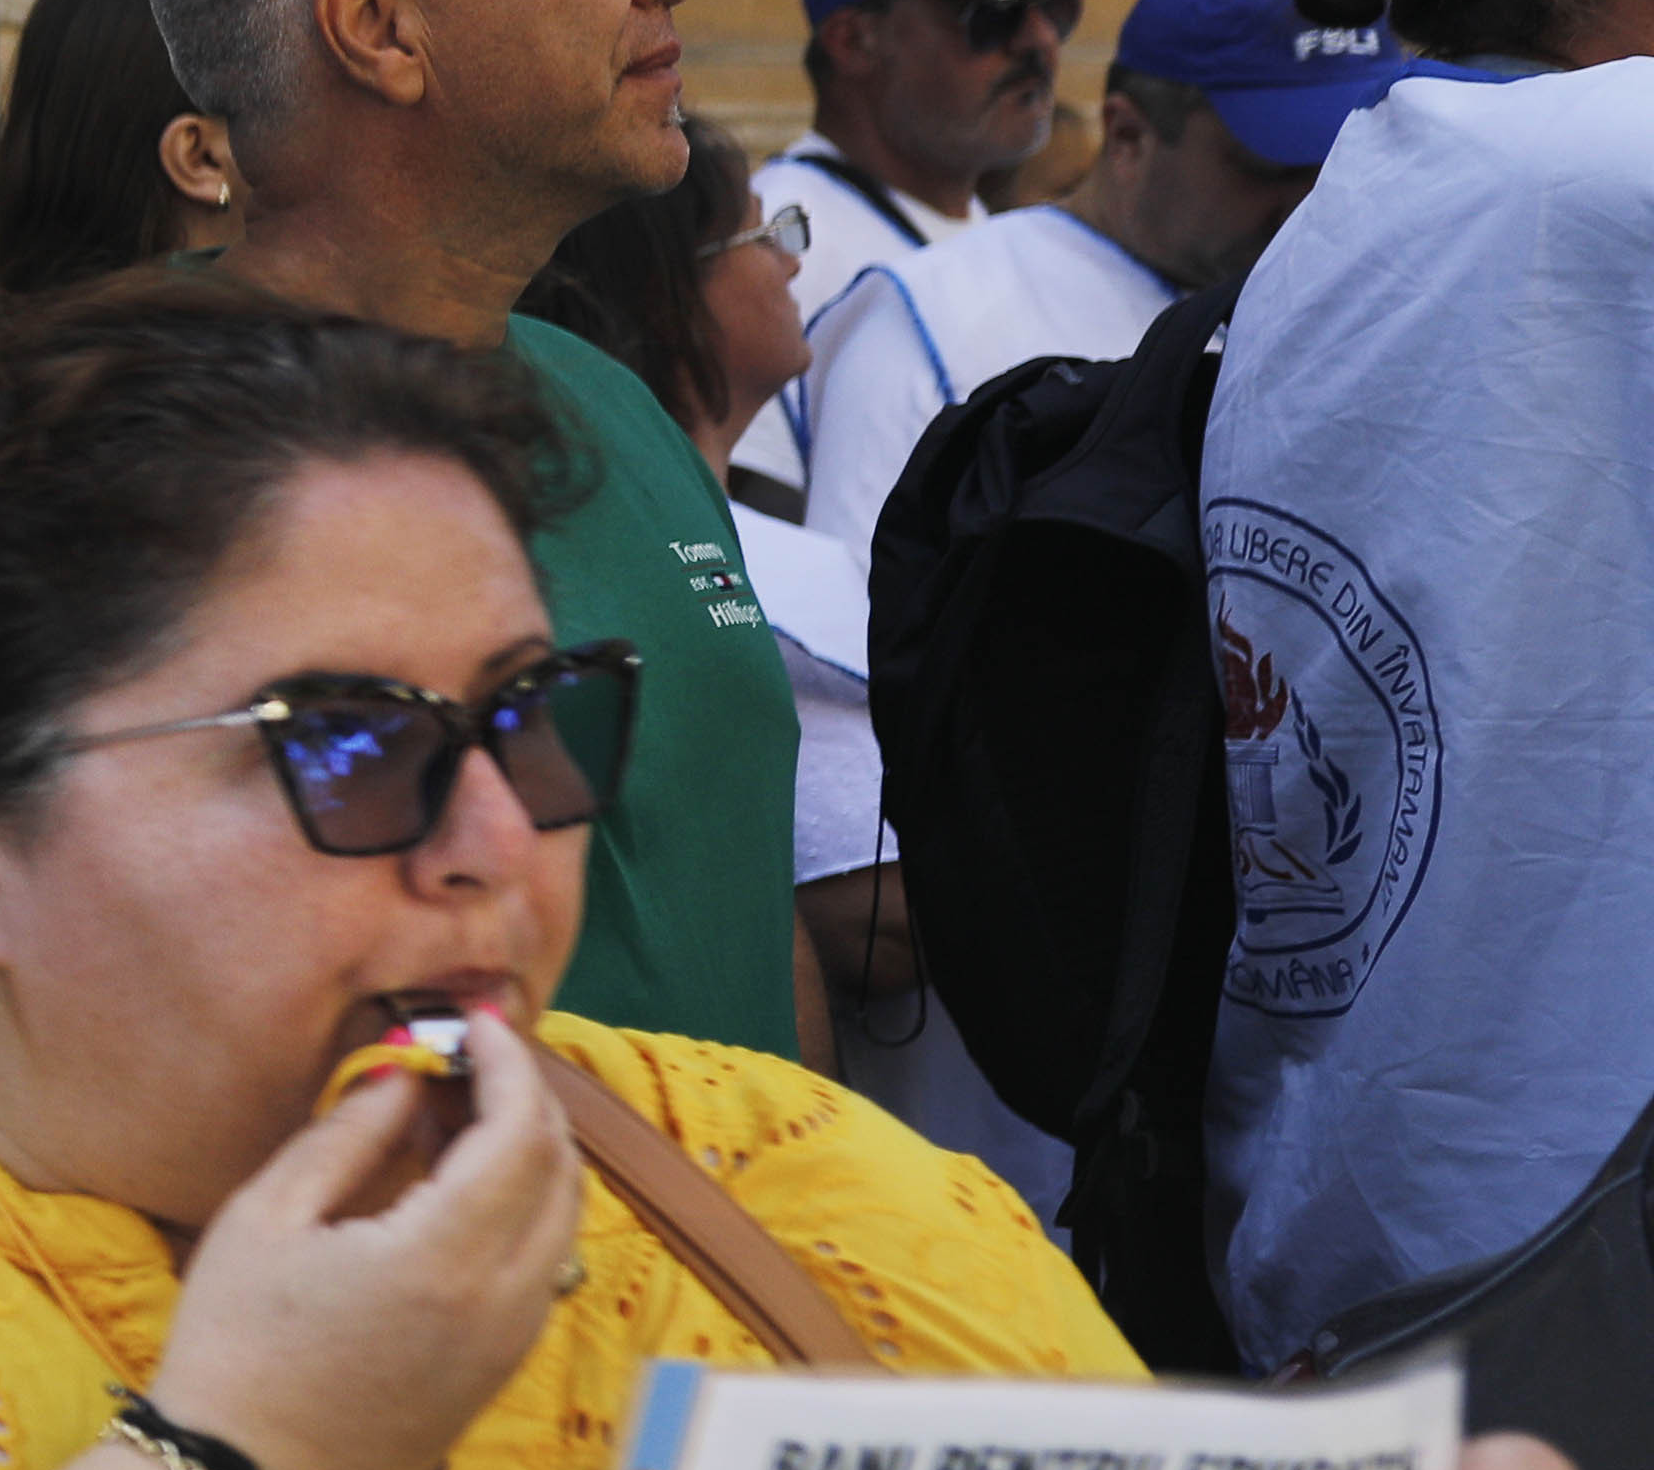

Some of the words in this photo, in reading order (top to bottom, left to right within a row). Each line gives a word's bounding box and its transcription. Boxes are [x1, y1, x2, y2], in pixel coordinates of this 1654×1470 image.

[669, 540, 727, 564] Tommy
[1229, 523, 1335, 597] LIBERE
[1331, 581, 1383, 653] DIN
